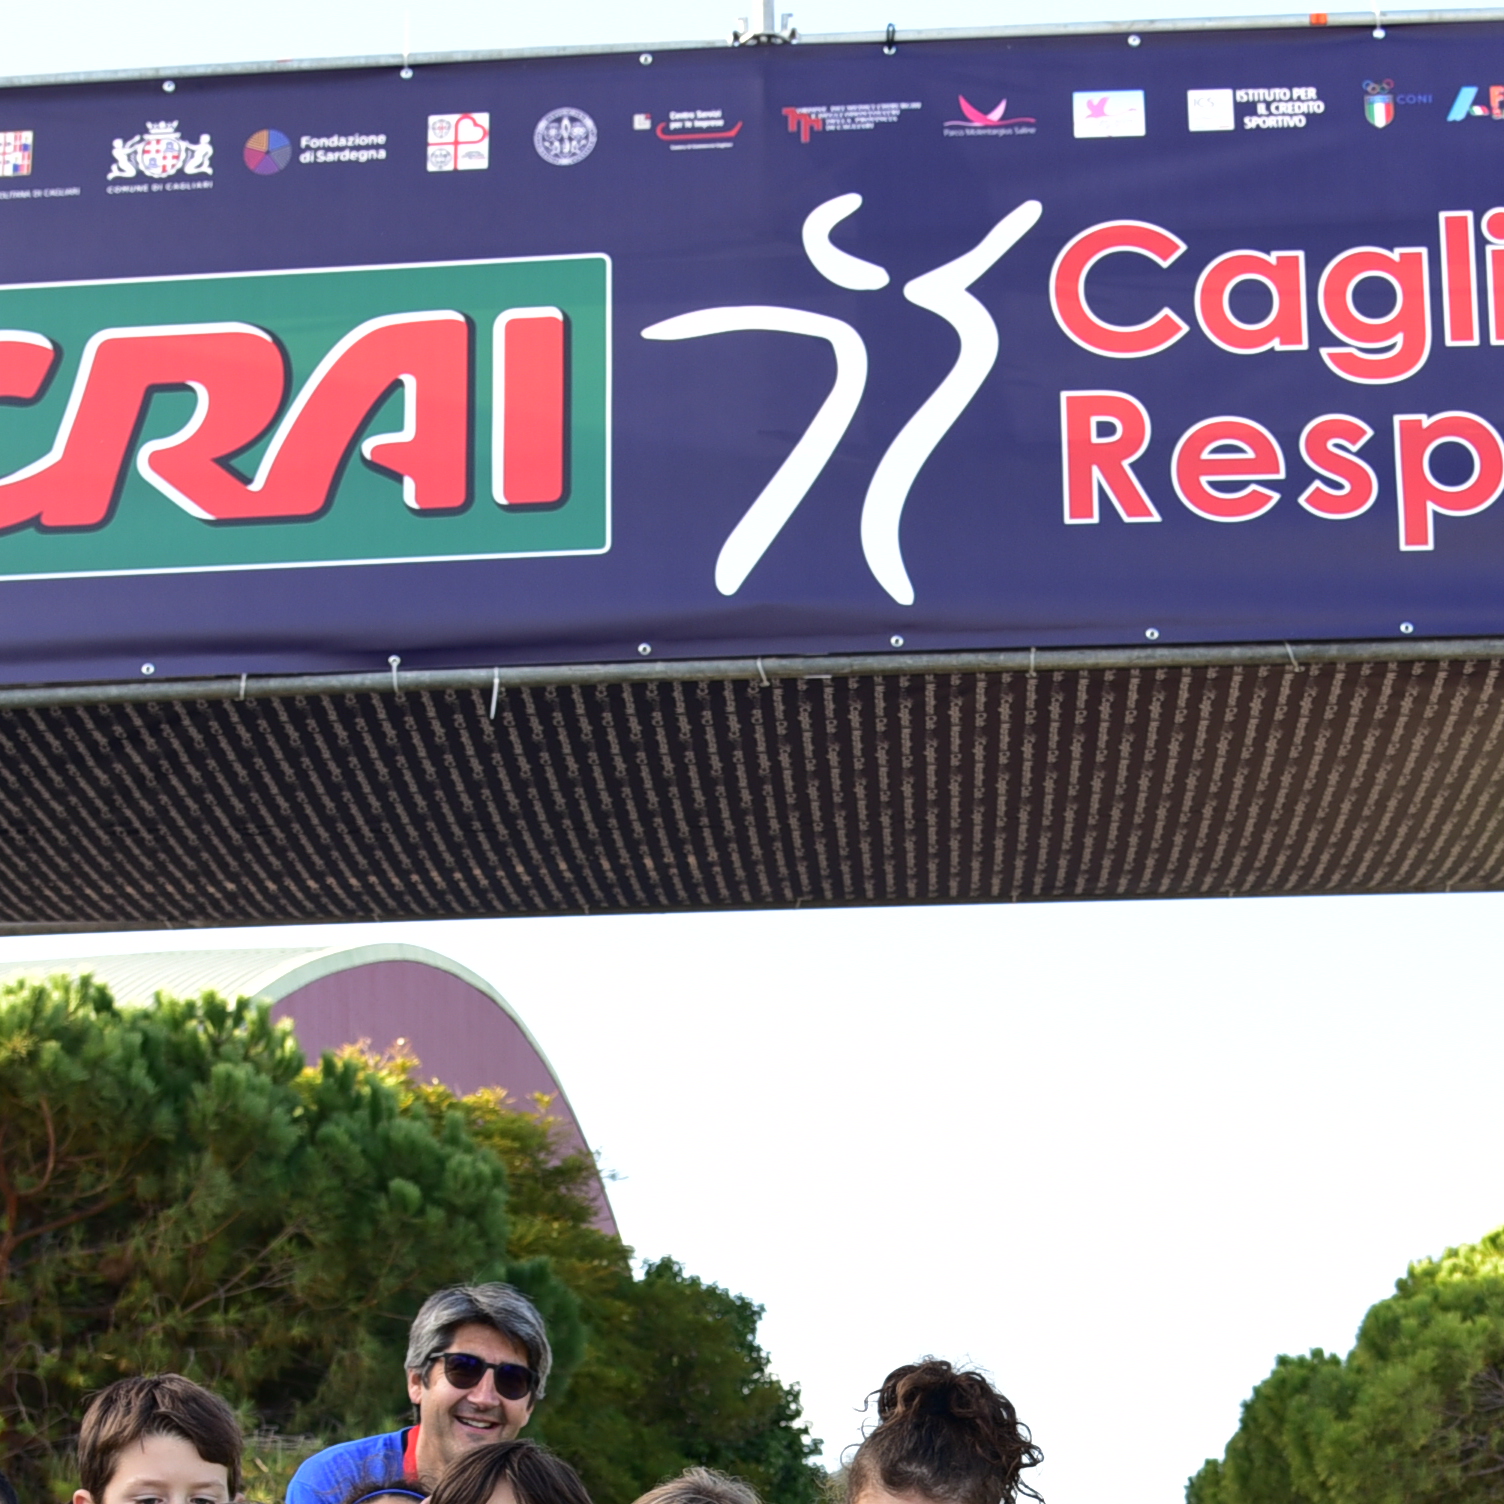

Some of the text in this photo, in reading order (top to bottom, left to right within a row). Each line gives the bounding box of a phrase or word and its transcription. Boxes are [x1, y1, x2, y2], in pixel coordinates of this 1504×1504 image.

[1236, 87, 1317, 102] ISTITUTO PER
[1397, 94, 1433, 104] CONI
[1271, 101, 1324, 114] CREDITO
[1244, 115, 1306, 129] SPORTIVO
[300, 134, 386, 149] Fondazione
[299, 148, 387, 163] di Sardegna
